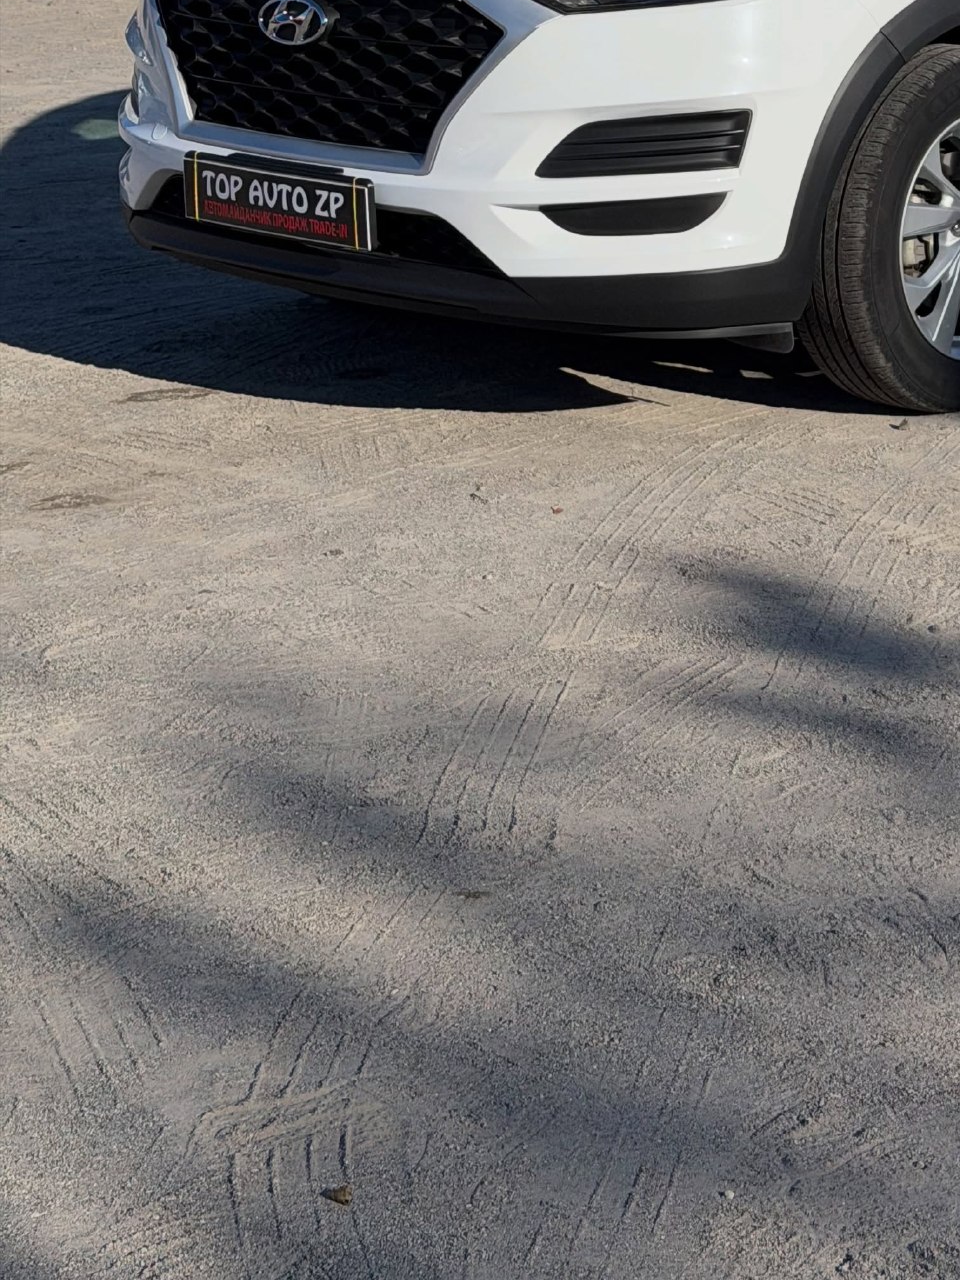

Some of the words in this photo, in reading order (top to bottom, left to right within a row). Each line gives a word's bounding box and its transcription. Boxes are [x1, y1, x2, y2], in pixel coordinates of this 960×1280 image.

[202, 170, 243, 202] TOP
[314, 189, 344, 219] ZP
[203, 199, 272, 227] АВТОМАЙДАНЧИК
[272, 213, 309, 234] ПРОДАЖ
[310, 219, 348, 239] TRADE-IN
